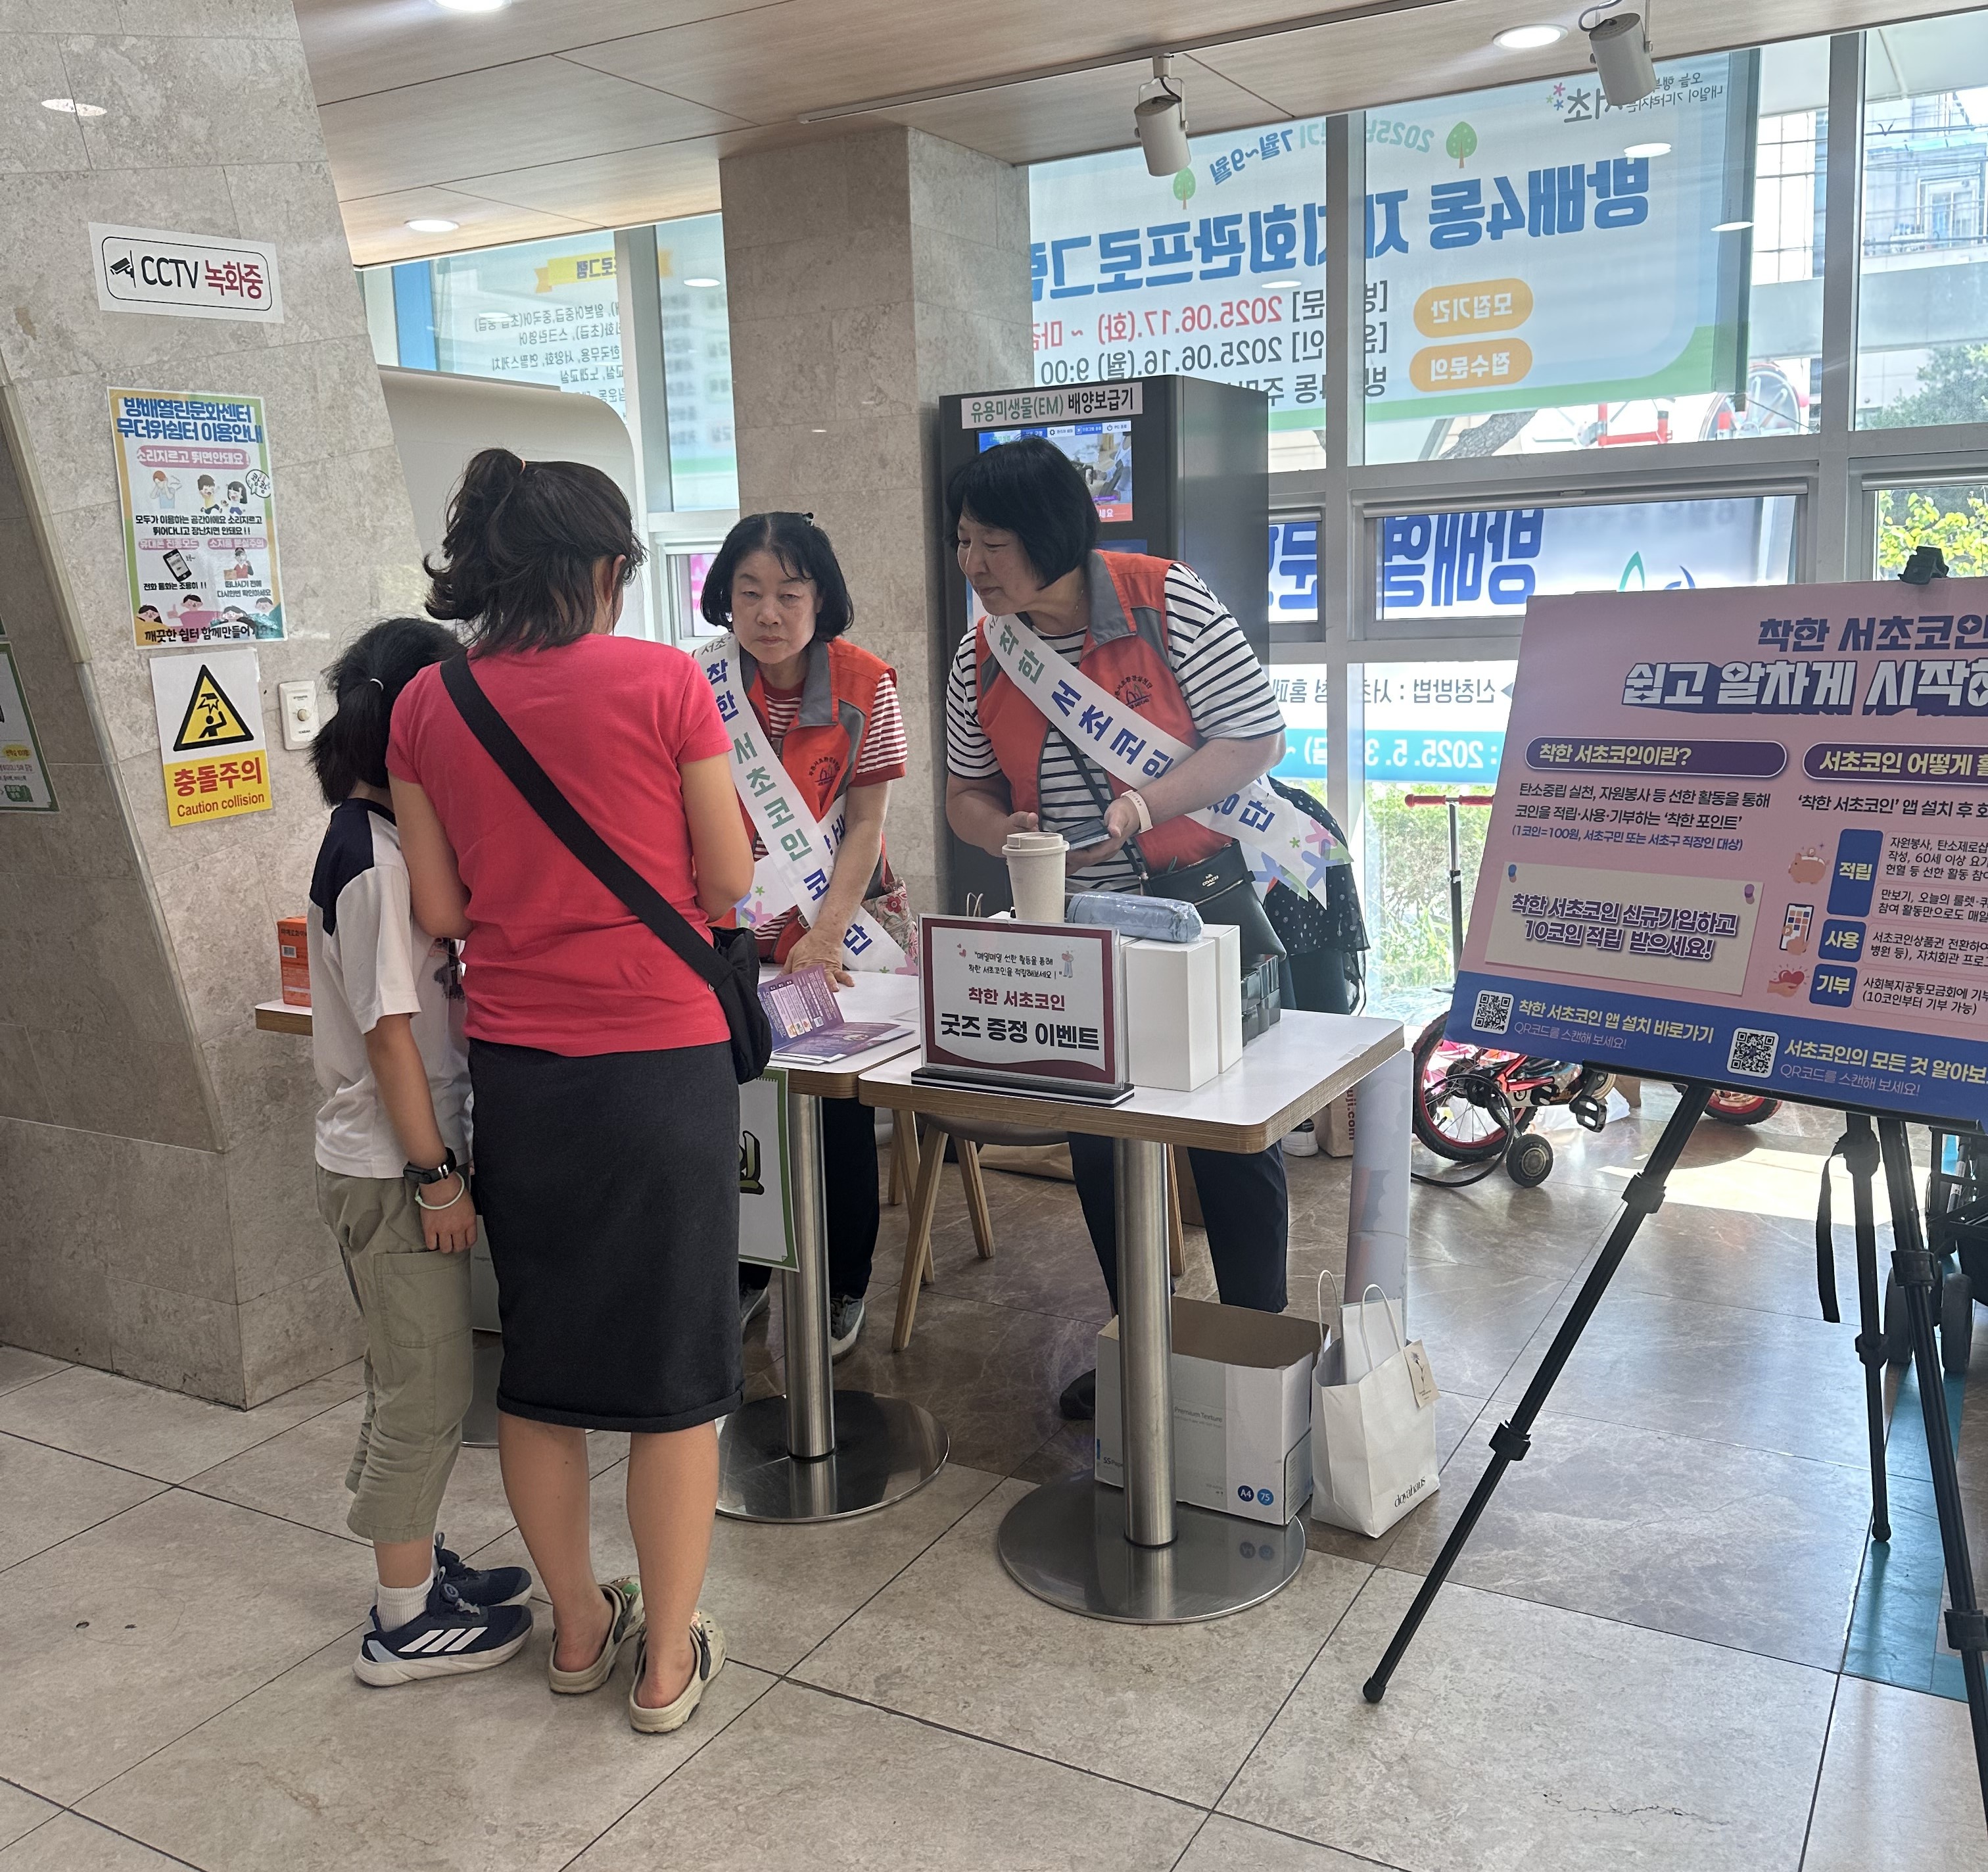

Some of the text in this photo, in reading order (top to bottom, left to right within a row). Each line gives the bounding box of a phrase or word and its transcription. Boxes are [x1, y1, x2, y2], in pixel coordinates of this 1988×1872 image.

[141, 256, 264, 300] CCTV 녹화중
[123, 396, 252, 423] 방배열린문화센터
[970, 387, 1133, 423] 유용미생물(EM) 배양보급기
[116, 418, 264, 444] 무더위쉼터 이용안내
[136, 449, 190, 464] 소리지르고
[135, 515, 159, 525] 모두가
[143, 583, 157, 591] 전화
[145, 628, 200, 642] 깨끗한 쉼터
[1758, 618, 1831, 653] 착한
[999, 623, 1045, 685] 착한
[706, 658, 740, 723] 착한
[1625, 661, 1709, 707] 쉽고
[1717, 660, 1857, 707] 알차게
[1051, 679, 1175, 780] 서초코인
[1539, 743, 1692, 767] 착한 서초코인이란?
[1818, 750, 1904, 775] 서초코인
[1907, 753, 1973, 777] 어떻게
[174, 756, 263, 798] 충돌주의
[177, 792, 265, 818] Caution collision
[733, 731, 813, 862] 서초코인
[1519, 782, 1772, 809] 탄소중립 실천, 자원봉사 등 선한 활동을 통해
[1903, 799, 1918, 815] 앱
[1921, 800, 1952, 817] 설치
[1956, 802, 1974, 818] 후
[1515, 804, 1550, 821] 코인을
[1583, 828, 1624, 844] 서초구민
[1625, 832, 1646, 846] 또는
[1648, 833, 1680, 848] 서초구
[1682, 834, 1715, 850] 직장인
[1716, 837, 1743, 852] 대상)
[1890, 837, 1933, 852] 자원봉사,
[1839, 863, 1873, 881] 적립
[1888, 851, 1966, 867] 작성, 60세 이상
[1886, 864, 1968, 881] 헌혈 등 선한 활동
[1882, 889, 1951, 905] 만보기, 오늘의
[1511, 892, 1739, 936] 착한 서초코인 신규가입하고
[1879, 902, 1899, 915] 참여
[1902, 904, 1965, 921] 활동만으로도
[1525, 919, 1715, 961] 10코인 적립 받으세요!
[1825, 930, 1860, 949] 사용
[1871, 944, 1891, 957] 병원
[1916, 949, 1960, 965] 자치회관
[968, 964, 982, 973] 착한
[1816, 974, 1851, 995] 기부
[1863, 977, 1968, 1000] 사회복지공동모금회에
[968, 987, 1066, 1011] 착한 서초코인
[1862, 990, 1977, 1016] (10코인부터 기부 가능)
[941, 1013, 1100, 1051] 굿즈 증정 이벤트
[1519, 999, 1715, 1044] 착한 서초코인 앱 설치 바로가기
[1514, 1020, 1628, 1051] QR코드를 스캔해 보세요!
[1784, 1039, 1929, 1076] 서초코인의 모든 것
[1780, 1063, 1921, 1097] QR코드를 스캔해 보세요!
[1240, 1489, 1270, 1502] A4 75
